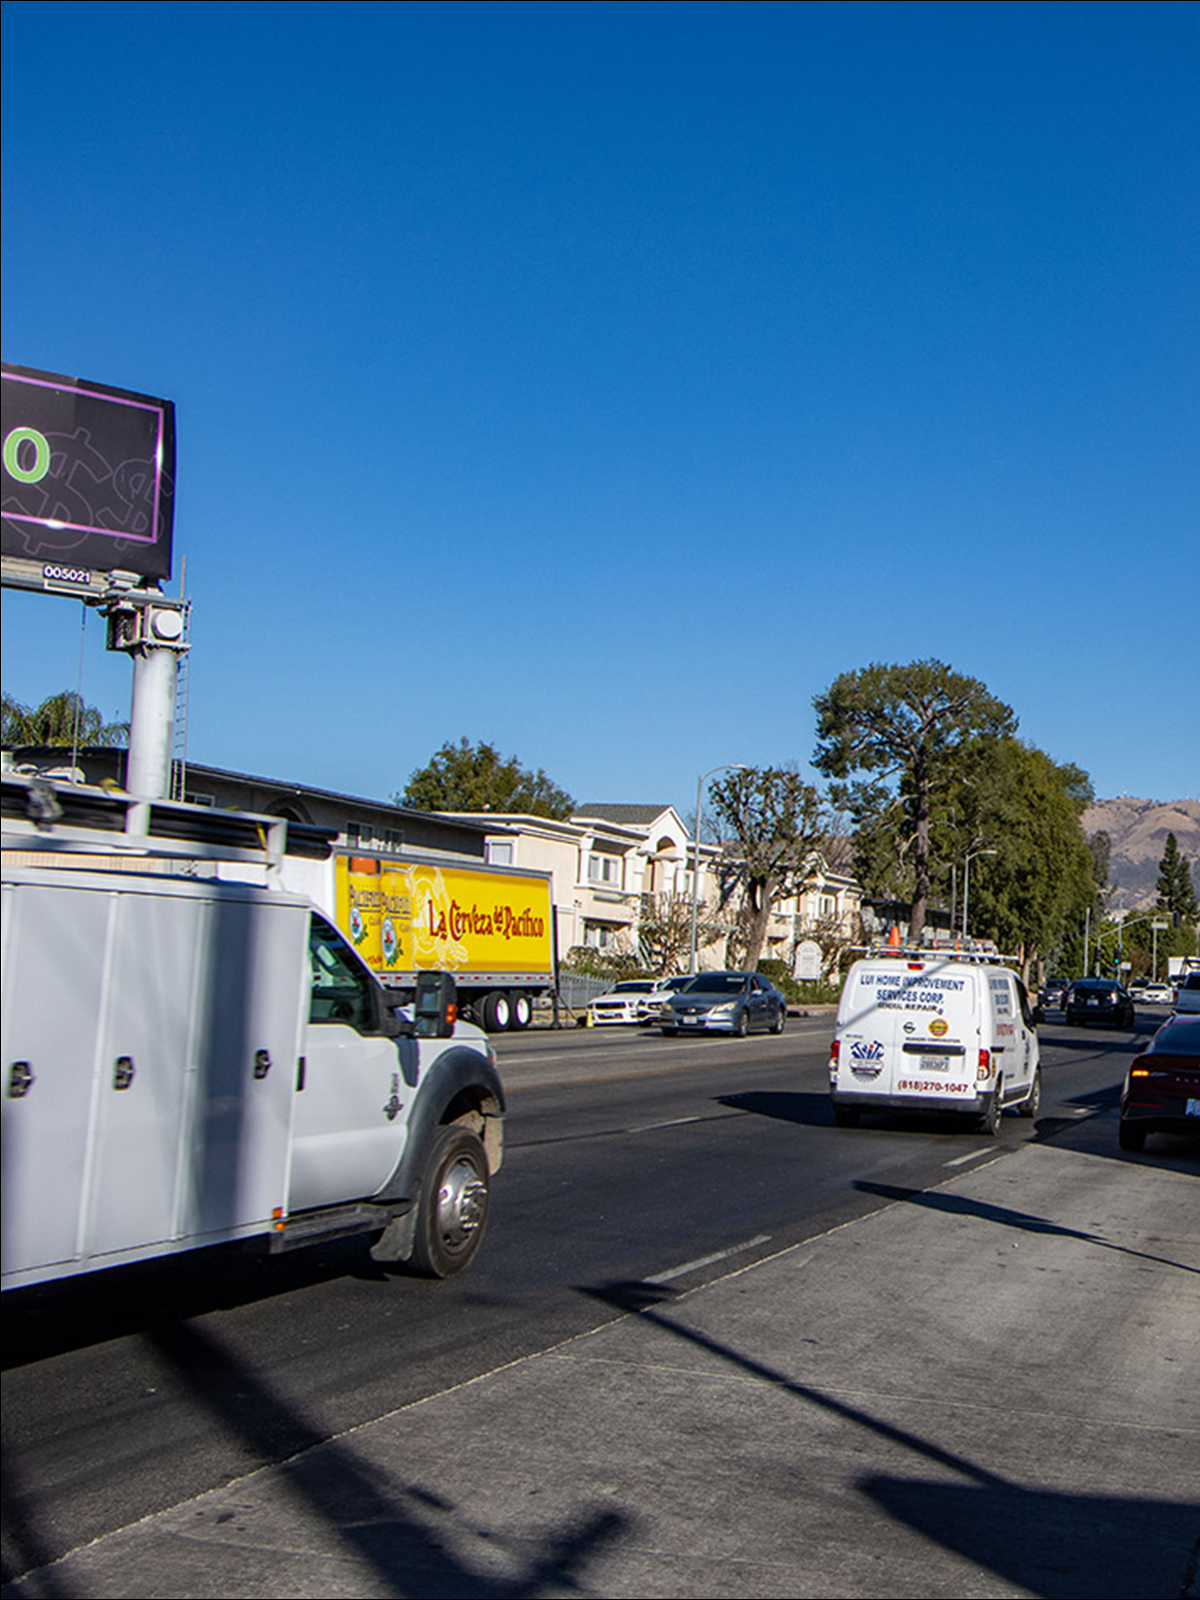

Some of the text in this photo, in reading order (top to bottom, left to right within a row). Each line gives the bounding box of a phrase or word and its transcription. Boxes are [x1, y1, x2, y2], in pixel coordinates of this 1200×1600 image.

[43, 565, 91, 583] 005021
[428, 899, 447, 940] La
[450, 899, 494, 941] Cerveza
[876, 975, 901, 987] HOME
[902, 976, 965, 991] IMPROVEMENT
[876, 989, 918, 1002] SERVICES
